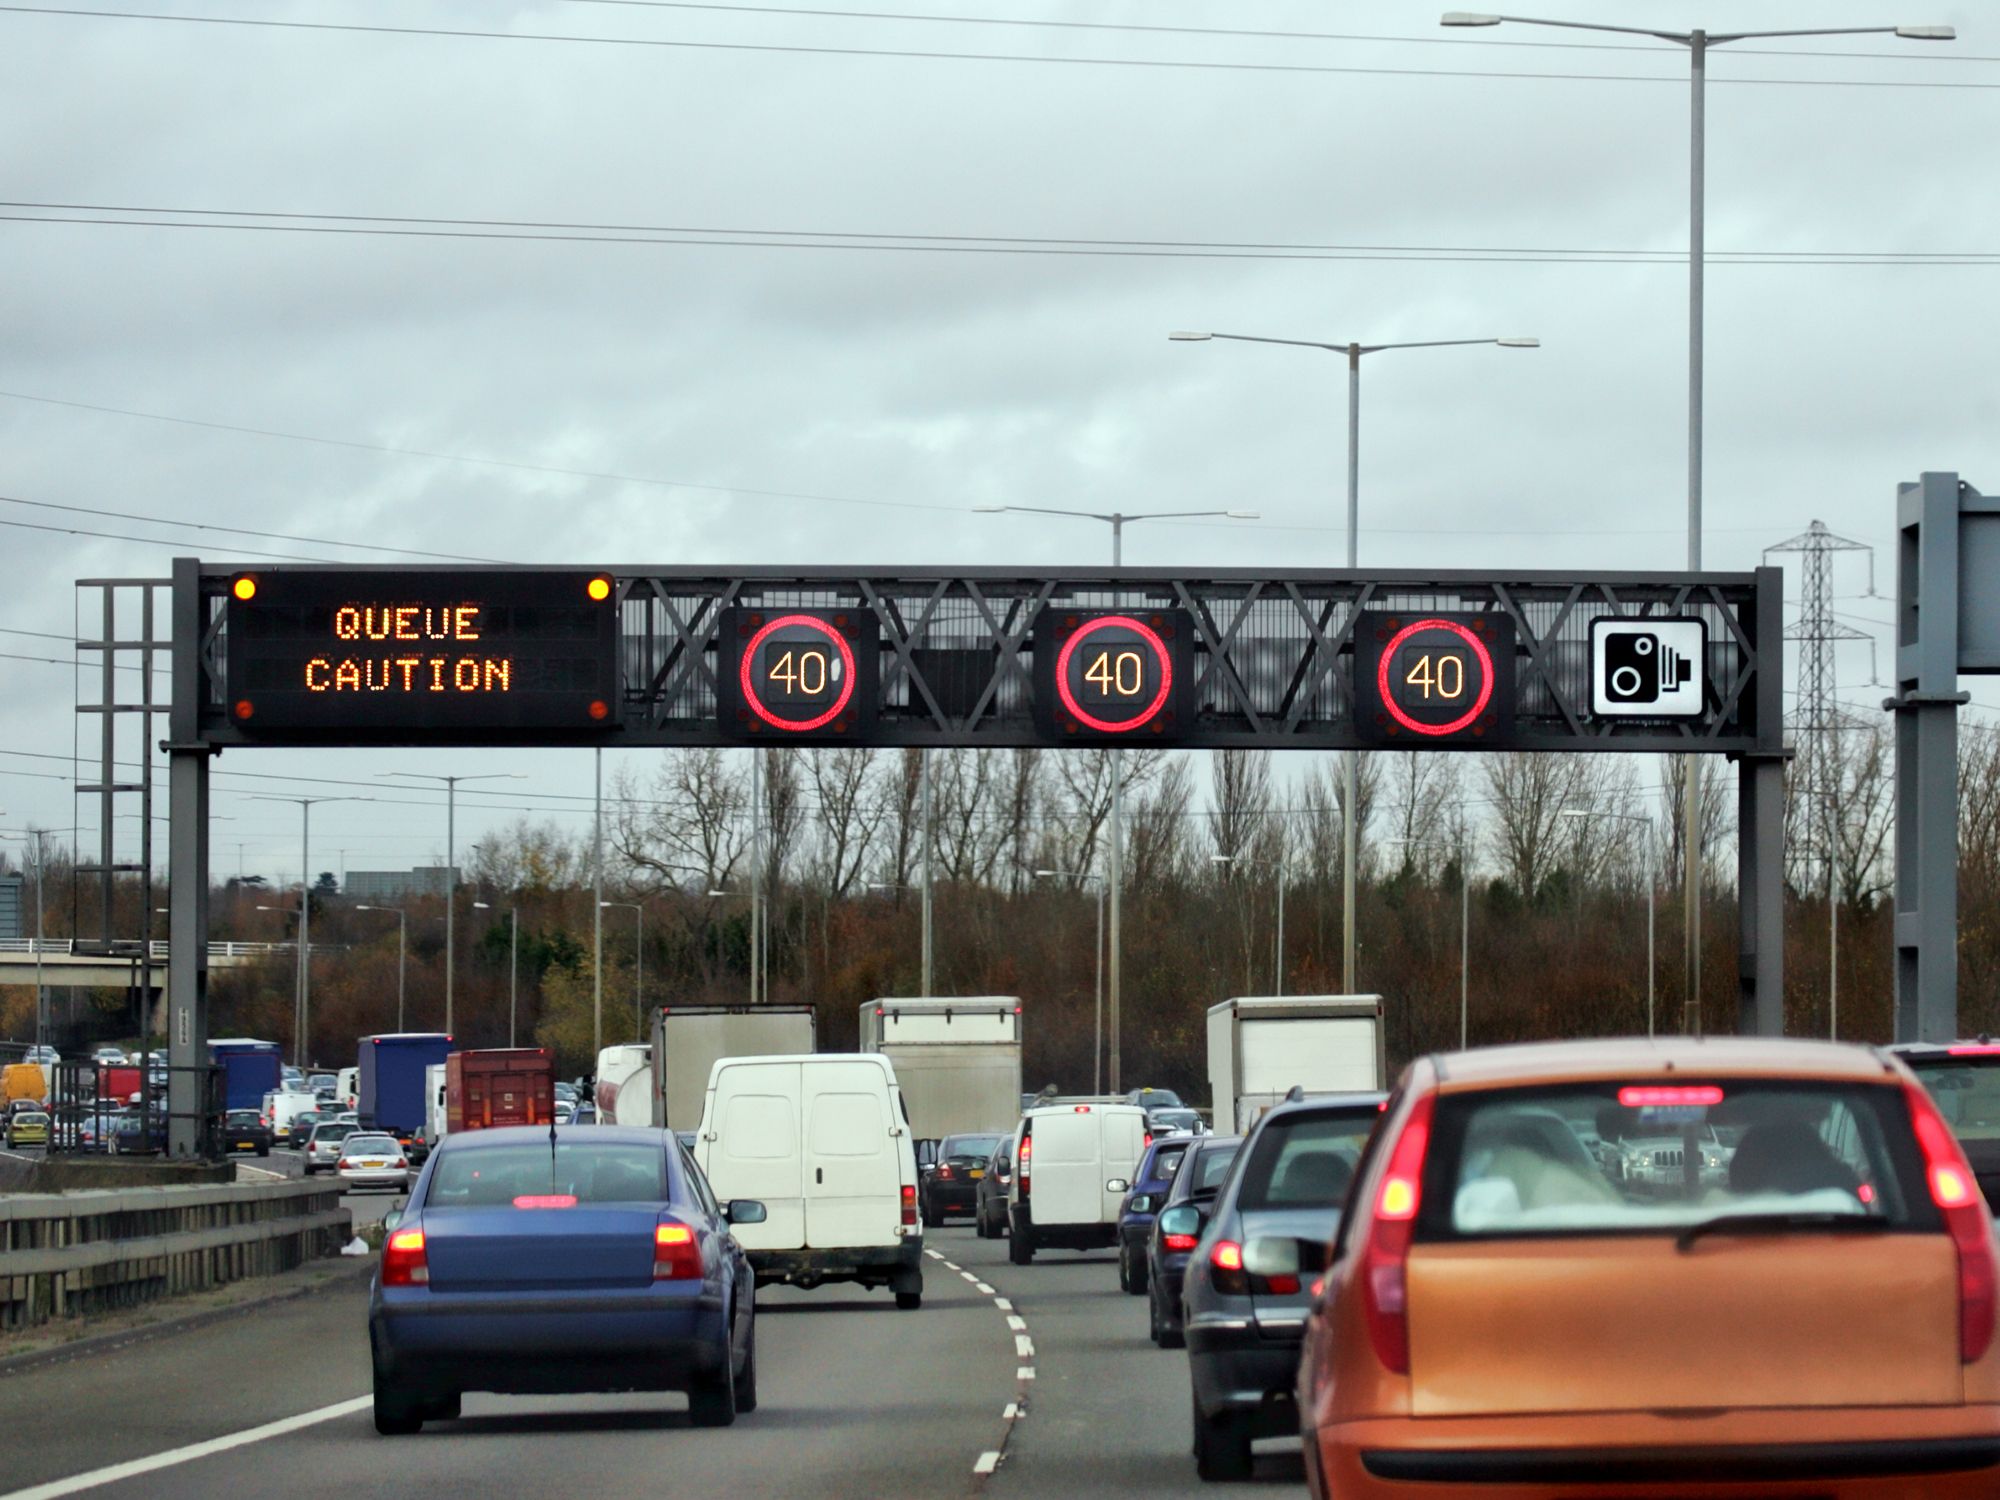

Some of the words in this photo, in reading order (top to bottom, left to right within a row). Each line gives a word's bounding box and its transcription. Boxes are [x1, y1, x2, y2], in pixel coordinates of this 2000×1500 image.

[336, 606, 479, 640] QUEUE
[306, 659, 509, 691] CAUTION
[769, 651, 826, 695] 40
[1084, 651, 1141, 696] 40
[1406, 654, 1463, 699] 40
